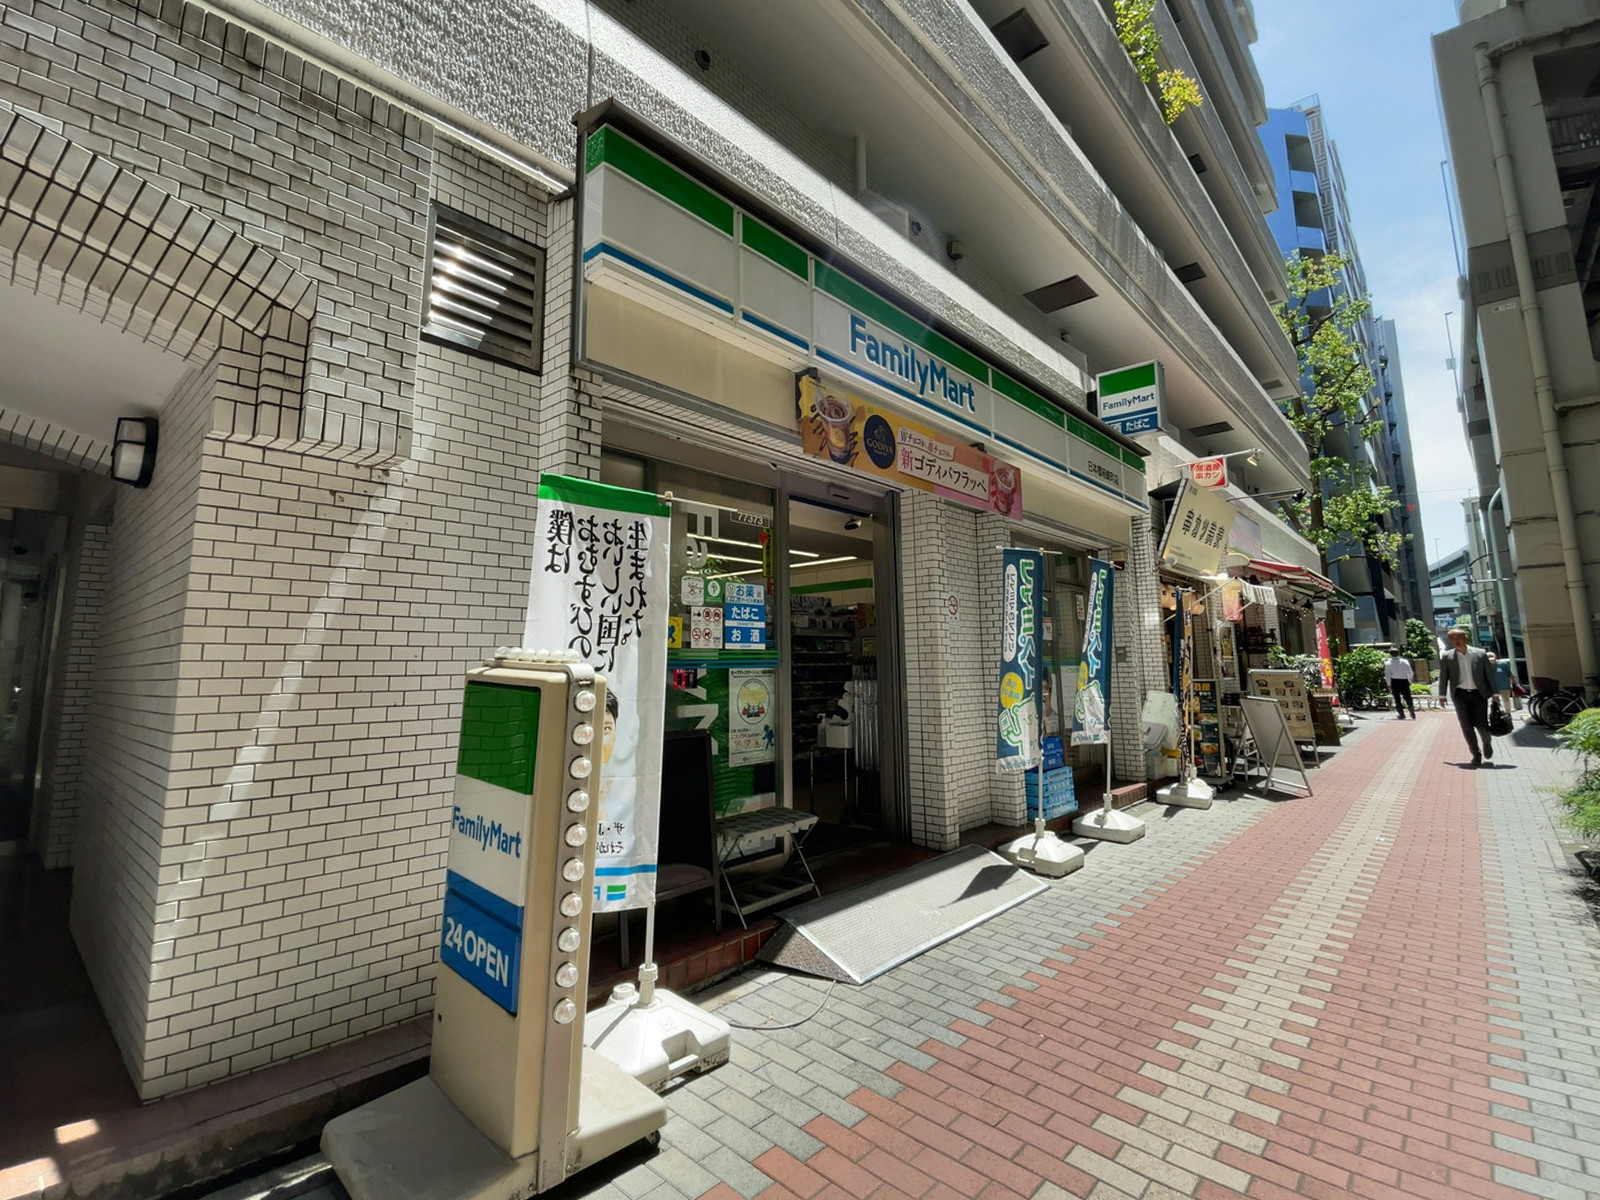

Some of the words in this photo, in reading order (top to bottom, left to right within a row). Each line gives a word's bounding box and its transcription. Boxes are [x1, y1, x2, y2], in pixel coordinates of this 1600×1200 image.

[850, 314, 976, 413] FamilyMart
[1102, 392, 1155, 411] FamilyMart
[1125, 418, 1150, 432] たばこ
[900, 447, 988, 494] 新ゴディバフラッペ
[737, 511, 764, 525] 77373
[735, 585, 755, 598] お薬
[731, 606, 760, 620] たばこ
[452, 806, 521, 858] FamilyMart
